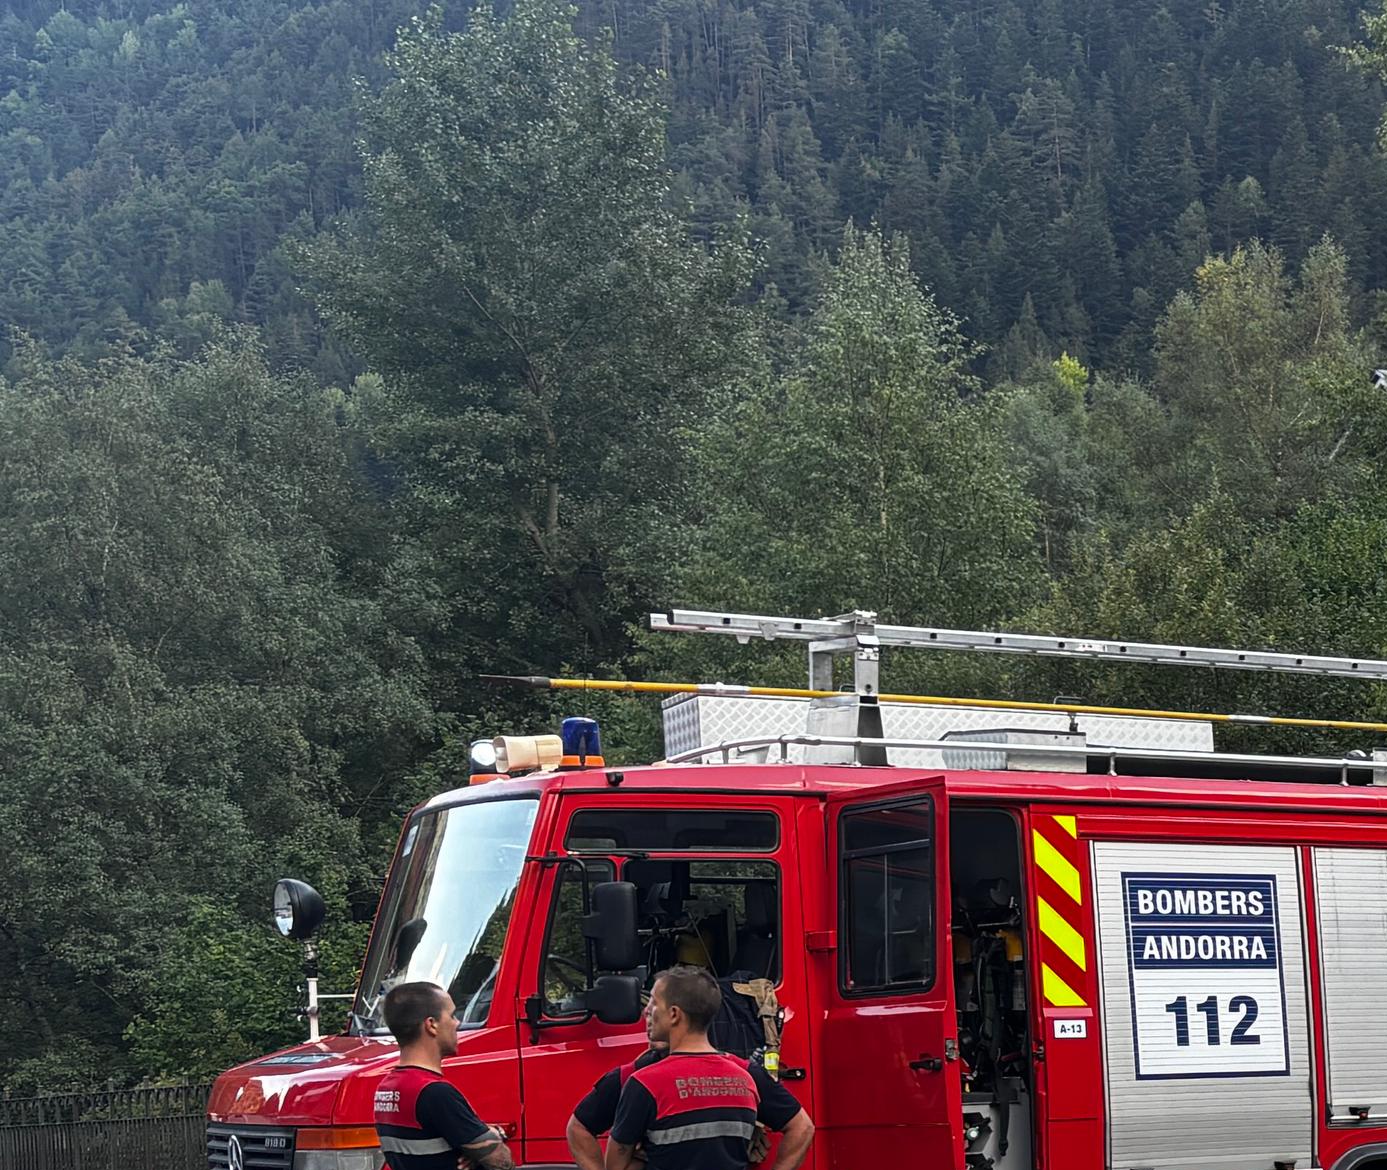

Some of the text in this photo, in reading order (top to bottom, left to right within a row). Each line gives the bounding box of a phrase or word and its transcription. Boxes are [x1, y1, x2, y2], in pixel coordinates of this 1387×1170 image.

[1138, 889, 1264, 915] BOMBERS
[1143, 935, 1267, 960] ANDORRA
[1060, 1024, 1082, 1033] A-13
[1166, 995, 1260, 1046] 112
